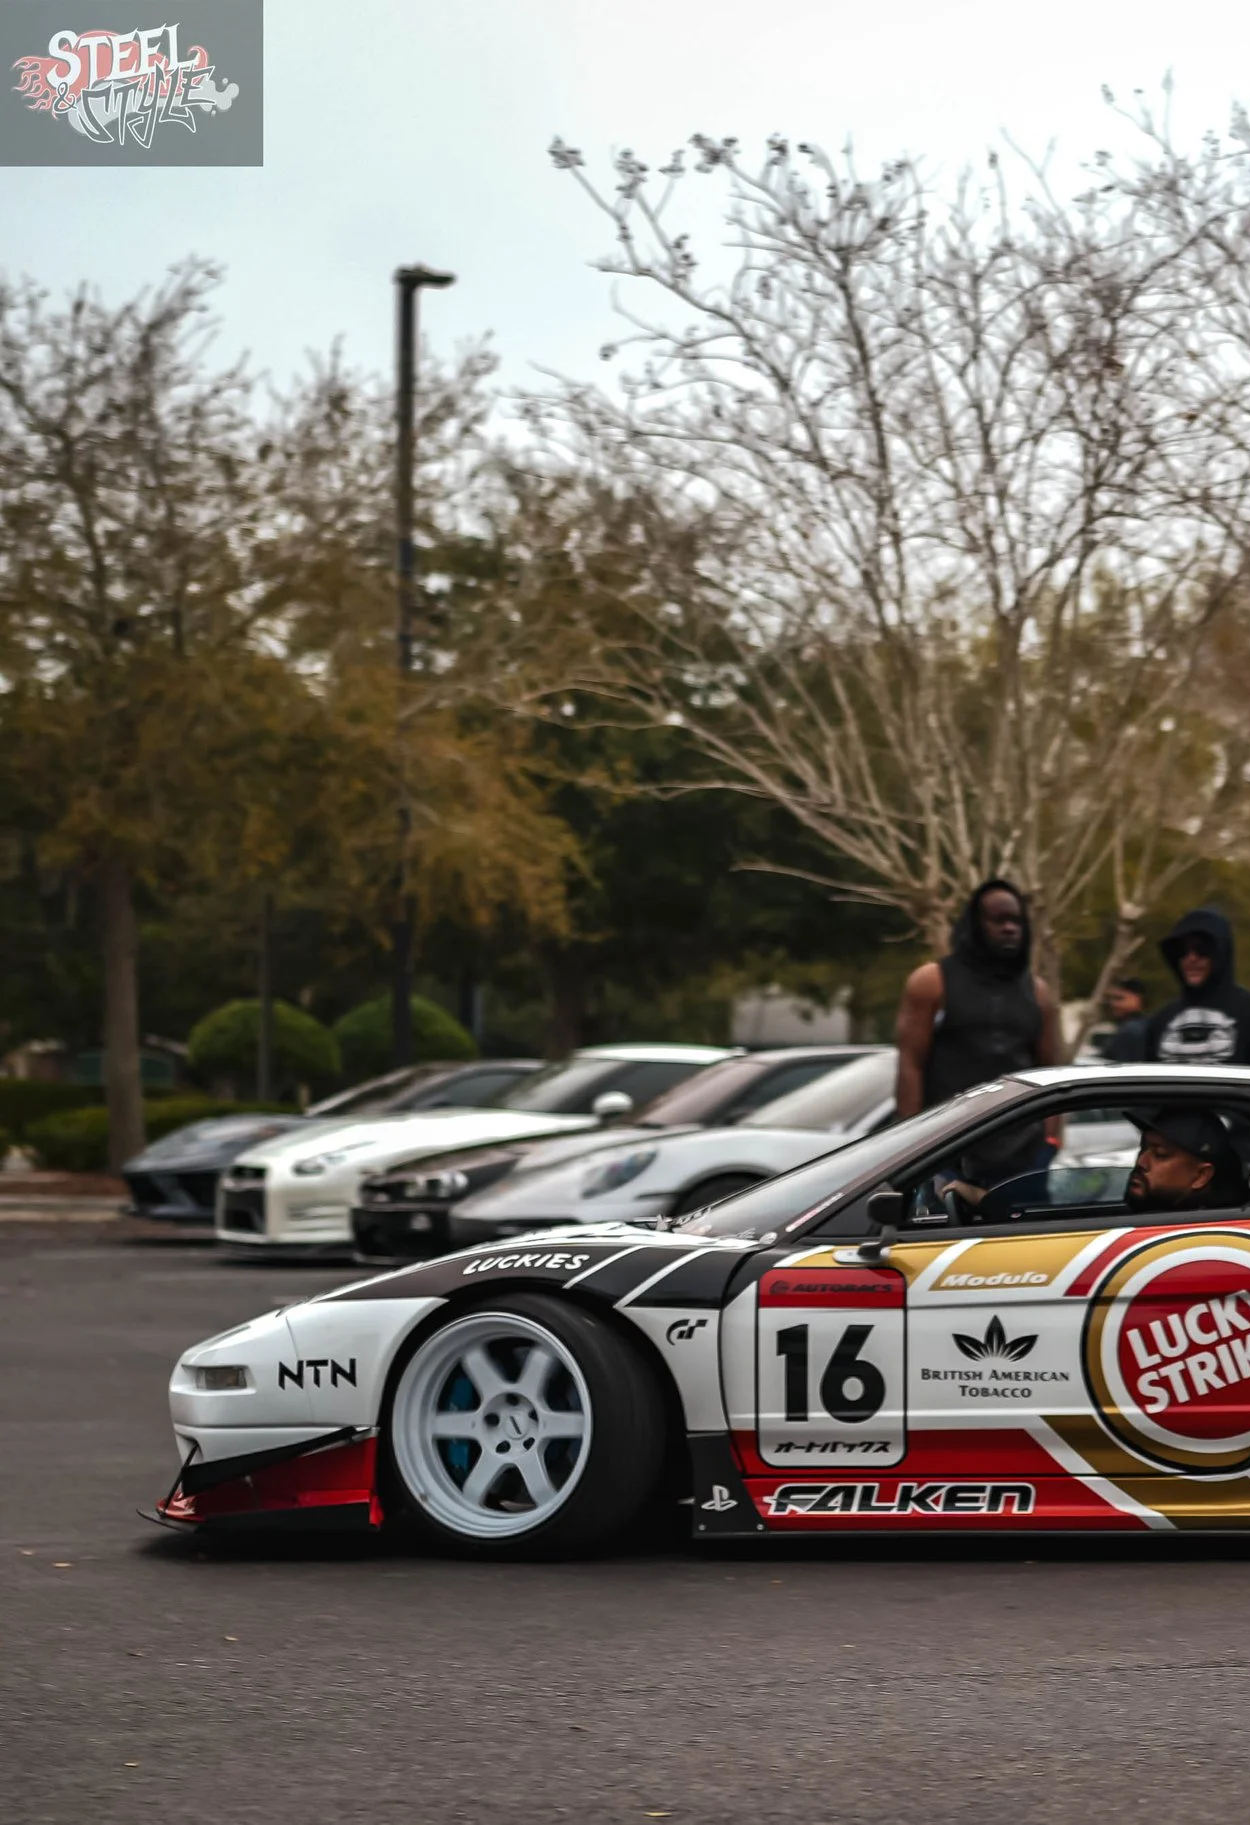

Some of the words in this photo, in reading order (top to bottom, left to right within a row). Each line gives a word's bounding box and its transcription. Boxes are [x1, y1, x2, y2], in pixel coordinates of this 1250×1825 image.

[462, 1253, 590, 1275] LUCKIES
[791, 1283, 893, 1293] AUTOBACS
[940, 1271, 1049, 1288] Modulo
[278, 1358, 357, 1390] NTN
[775, 1324, 886, 1423] 16
[921, 1369, 983, 1380] BRITISH
[989, 1370, 1070, 1382] AMERICAN
[959, 1385, 1032, 1398] TOBACCO
[774, 1441, 892, 1454] オートバックス
[763, 1483, 1035, 1515] FALKEN
